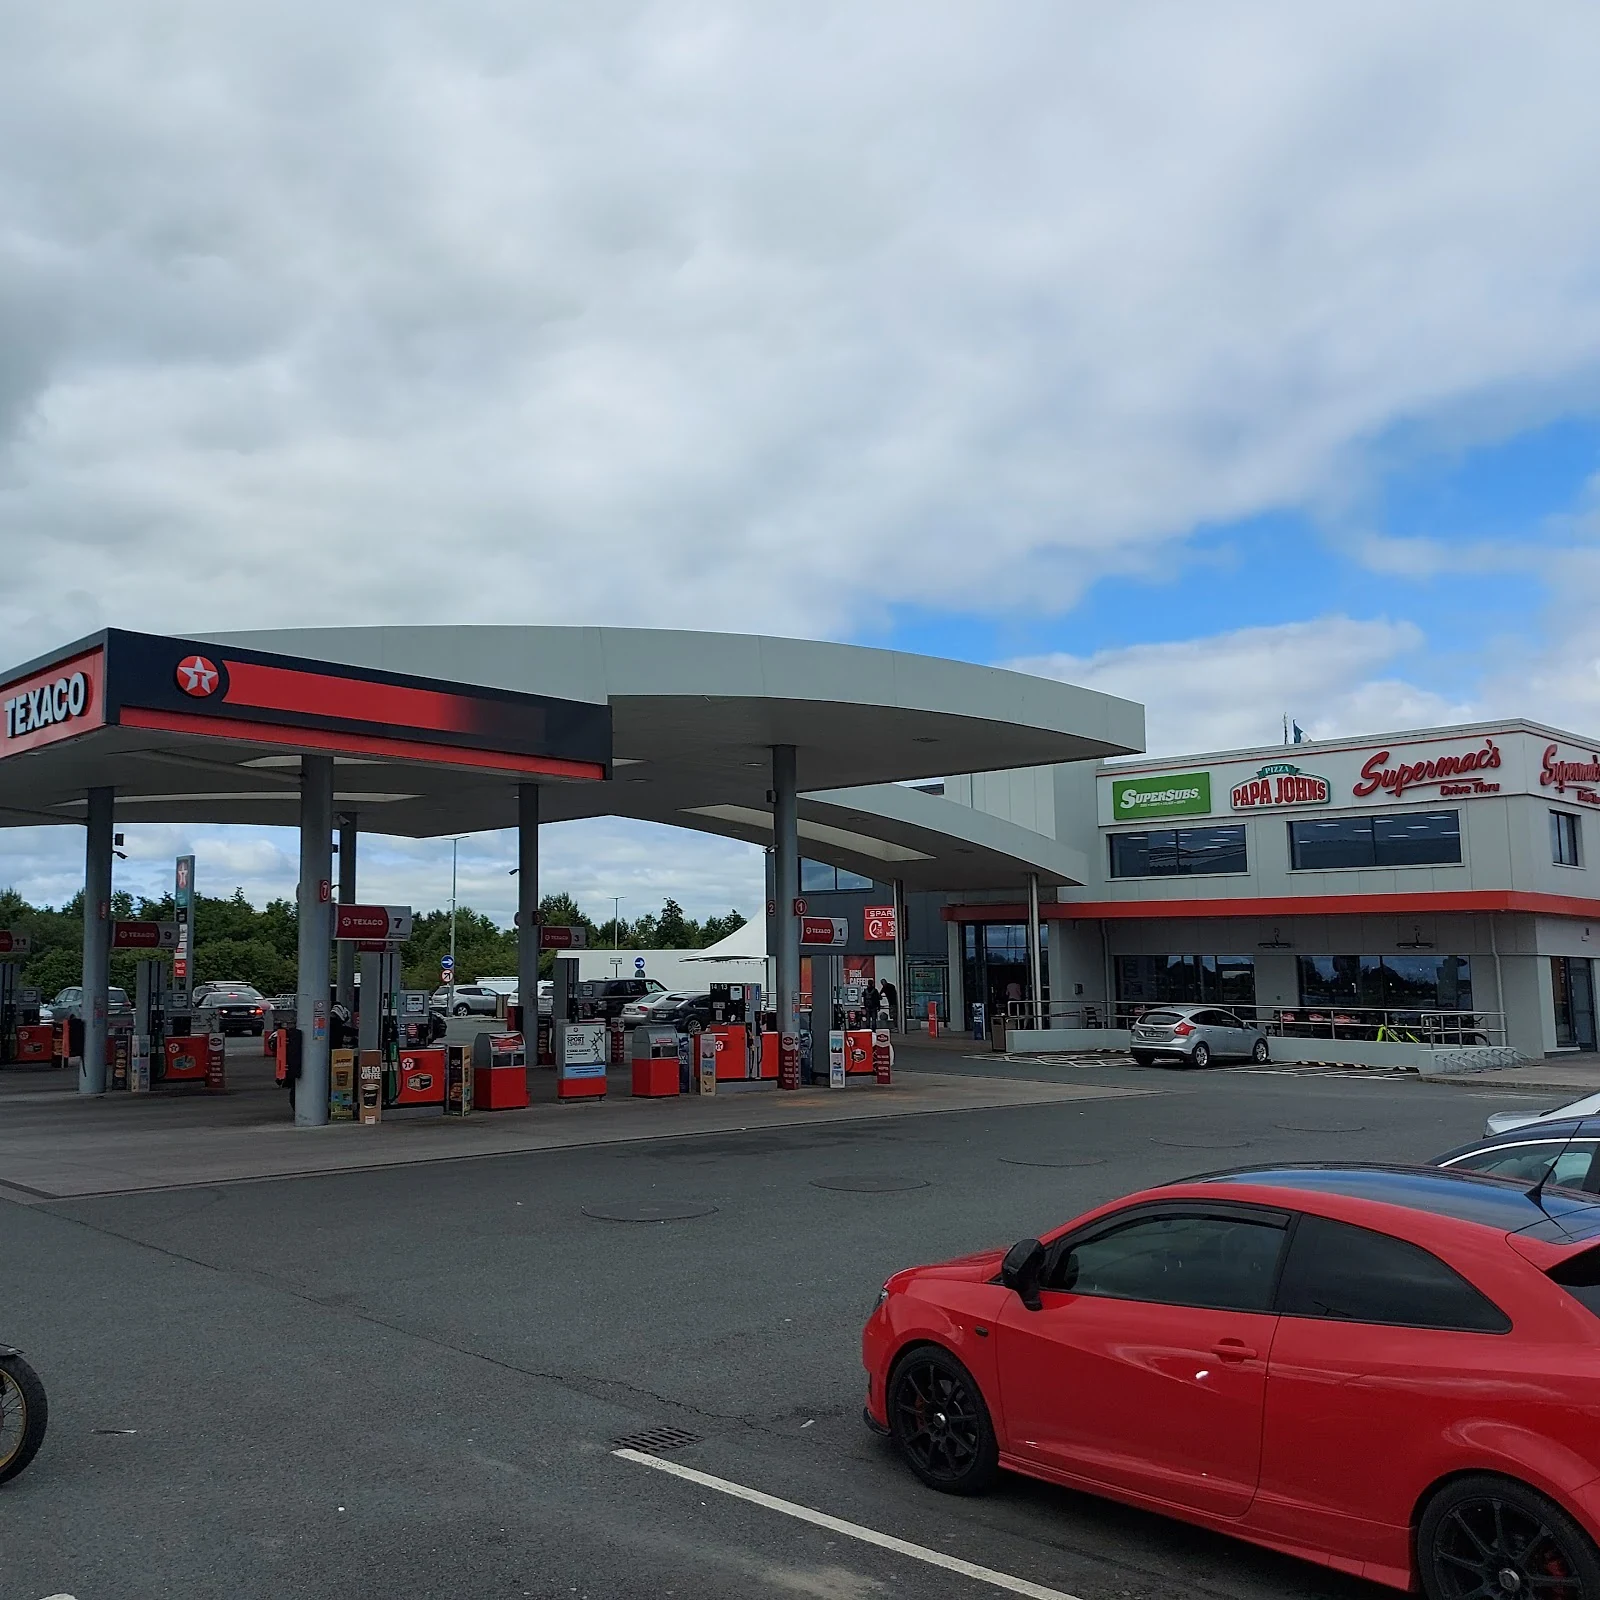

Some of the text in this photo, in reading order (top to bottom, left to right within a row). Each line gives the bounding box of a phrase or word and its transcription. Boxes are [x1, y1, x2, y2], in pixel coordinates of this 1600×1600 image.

[4, 671, 86, 738] TEXACO
[1264, 765, 1289, 775] PIZZA
[1353, 739, 1501, 797] Supermac's
[1233, 778, 1273, 807] PAPA
[1440, 781, 1501, 796] Drive Thru
[394, 918, 403, 929] 7
[164, 931, 172, 940] 9
[838, 928, 843, 937] 1
[15, 938, 27, 946] 11
[360, 1072, 381, 1080] COFFEE
